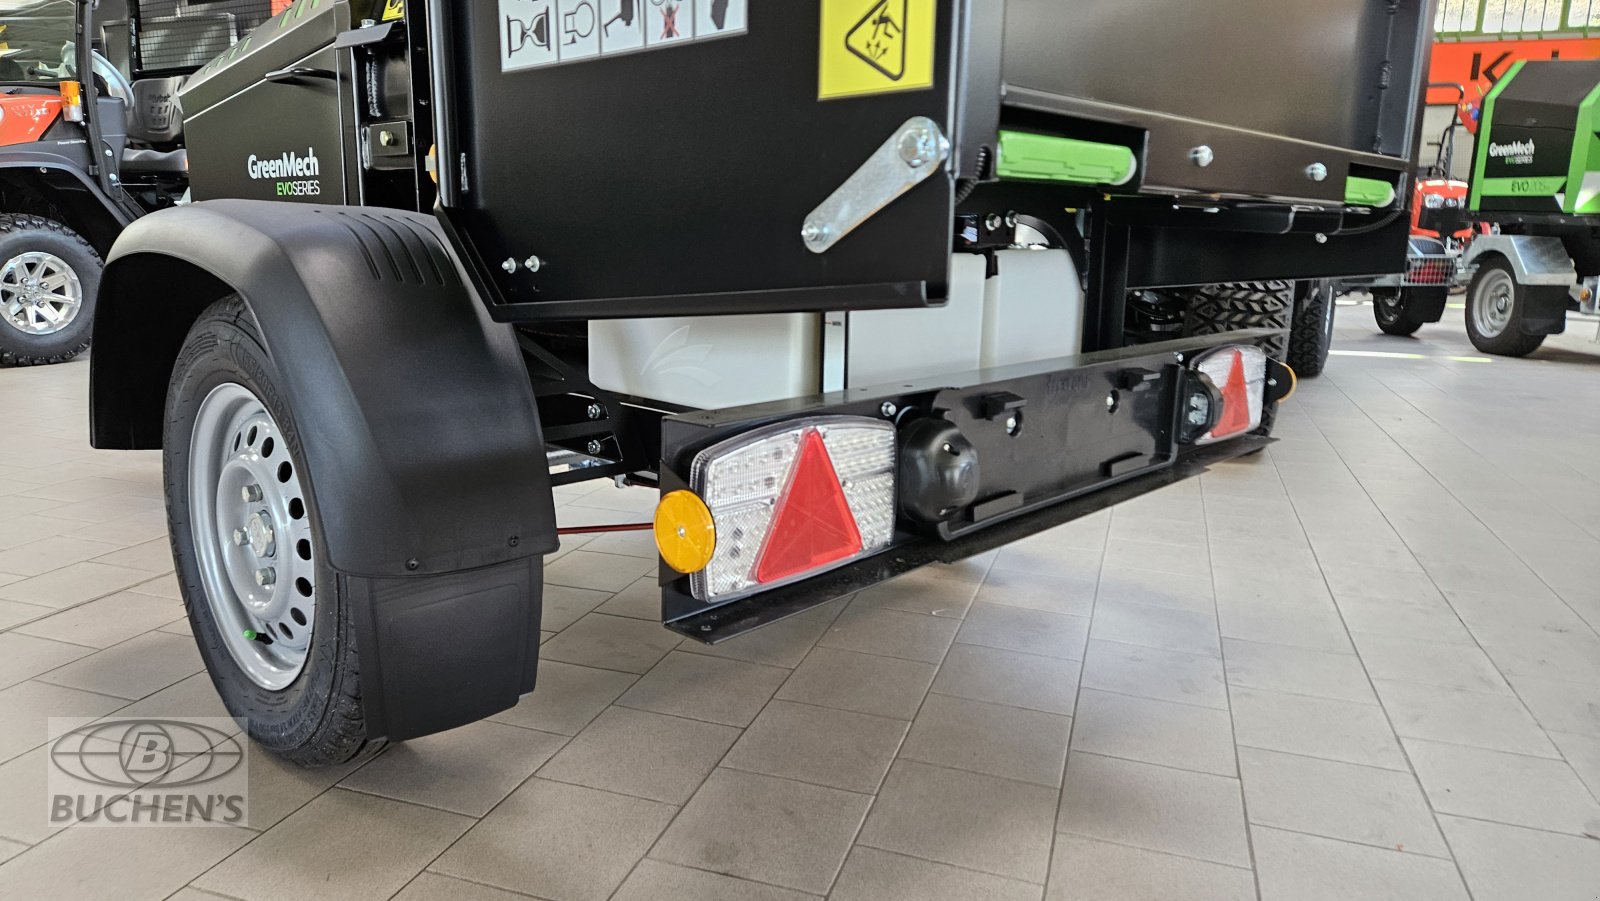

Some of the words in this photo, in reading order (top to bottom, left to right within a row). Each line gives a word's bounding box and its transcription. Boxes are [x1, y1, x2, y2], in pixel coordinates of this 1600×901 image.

[1489, 138, 1535, 158] GreenMech
[247, 146, 319, 179] GreenMech
[276, 180, 320, 195] EVOSERIES
